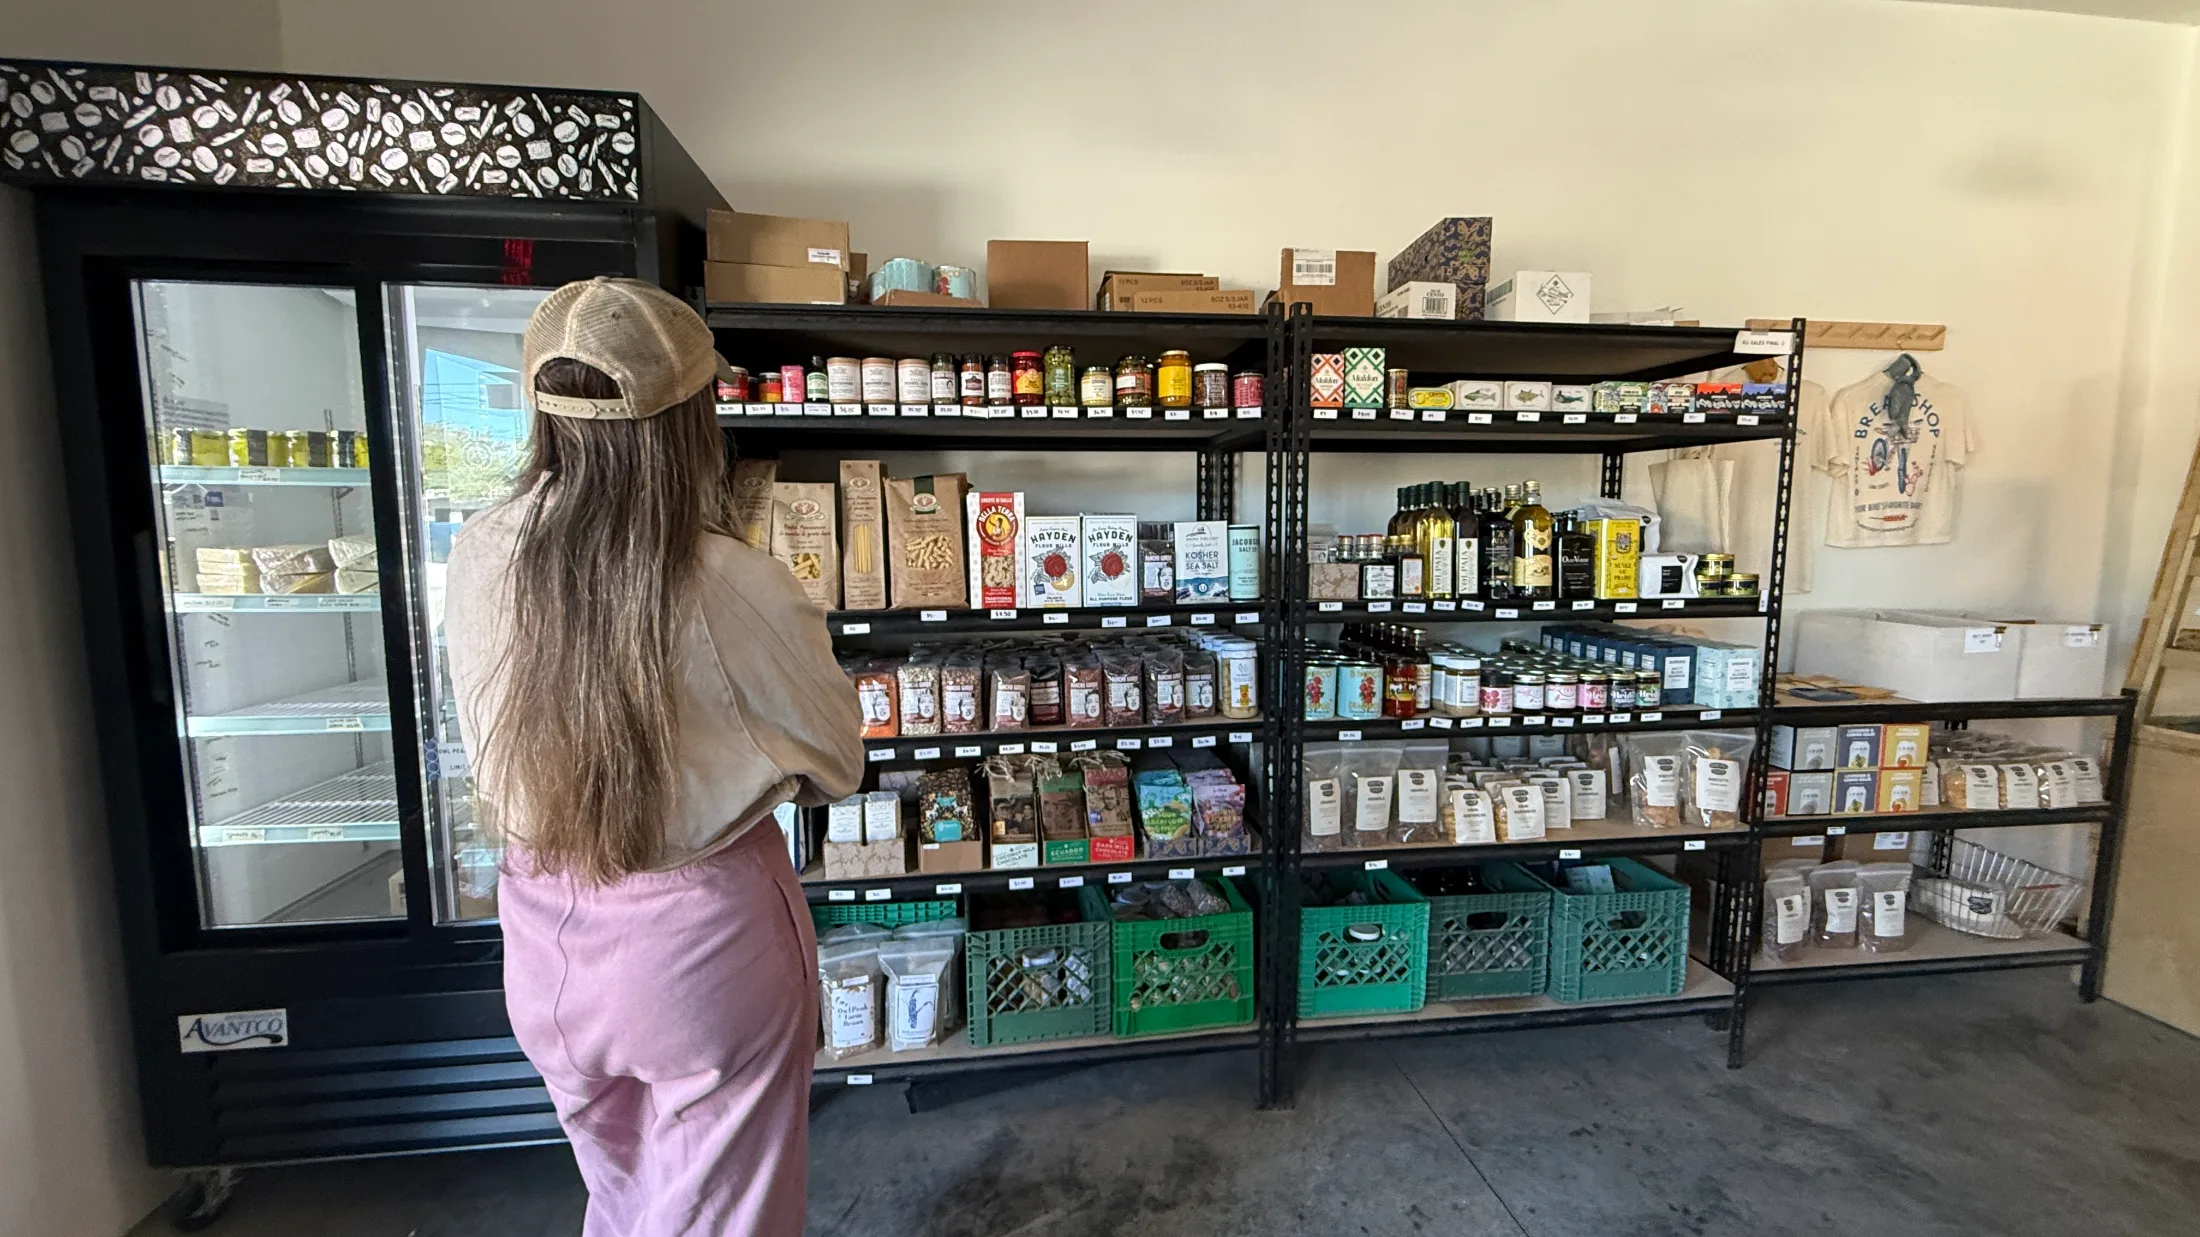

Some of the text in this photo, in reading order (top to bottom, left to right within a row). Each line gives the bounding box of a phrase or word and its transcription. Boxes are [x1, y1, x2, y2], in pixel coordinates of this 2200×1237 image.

[1315, 376, 1338, 384] Maldon
[1352, 374, 1379, 382] Maldon
[978, 505, 1016, 523] BELLA TERRA
[1030, 531, 1077, 544] HAYDEN
[1088, 530, 1133, 543] HAYDEN
[1185, 550, 1219, 559] KOSHER
[1185, 561, 1219, 570] SEA SALT
[1434, 549, 1442, 592] VOLPAIA
[1460, 549, 1468, 592] VOLPAIA
[995, 846, 1036, 861] COCONUT MILK
[1050, 847, 1084, 856] ECUADOR
[1095, 847, 1128, 855] CHOCOLATE
[997, 854, 1028, 866] CHOCOLATE
[183, 1017, 283, 1041] AVANTCO
